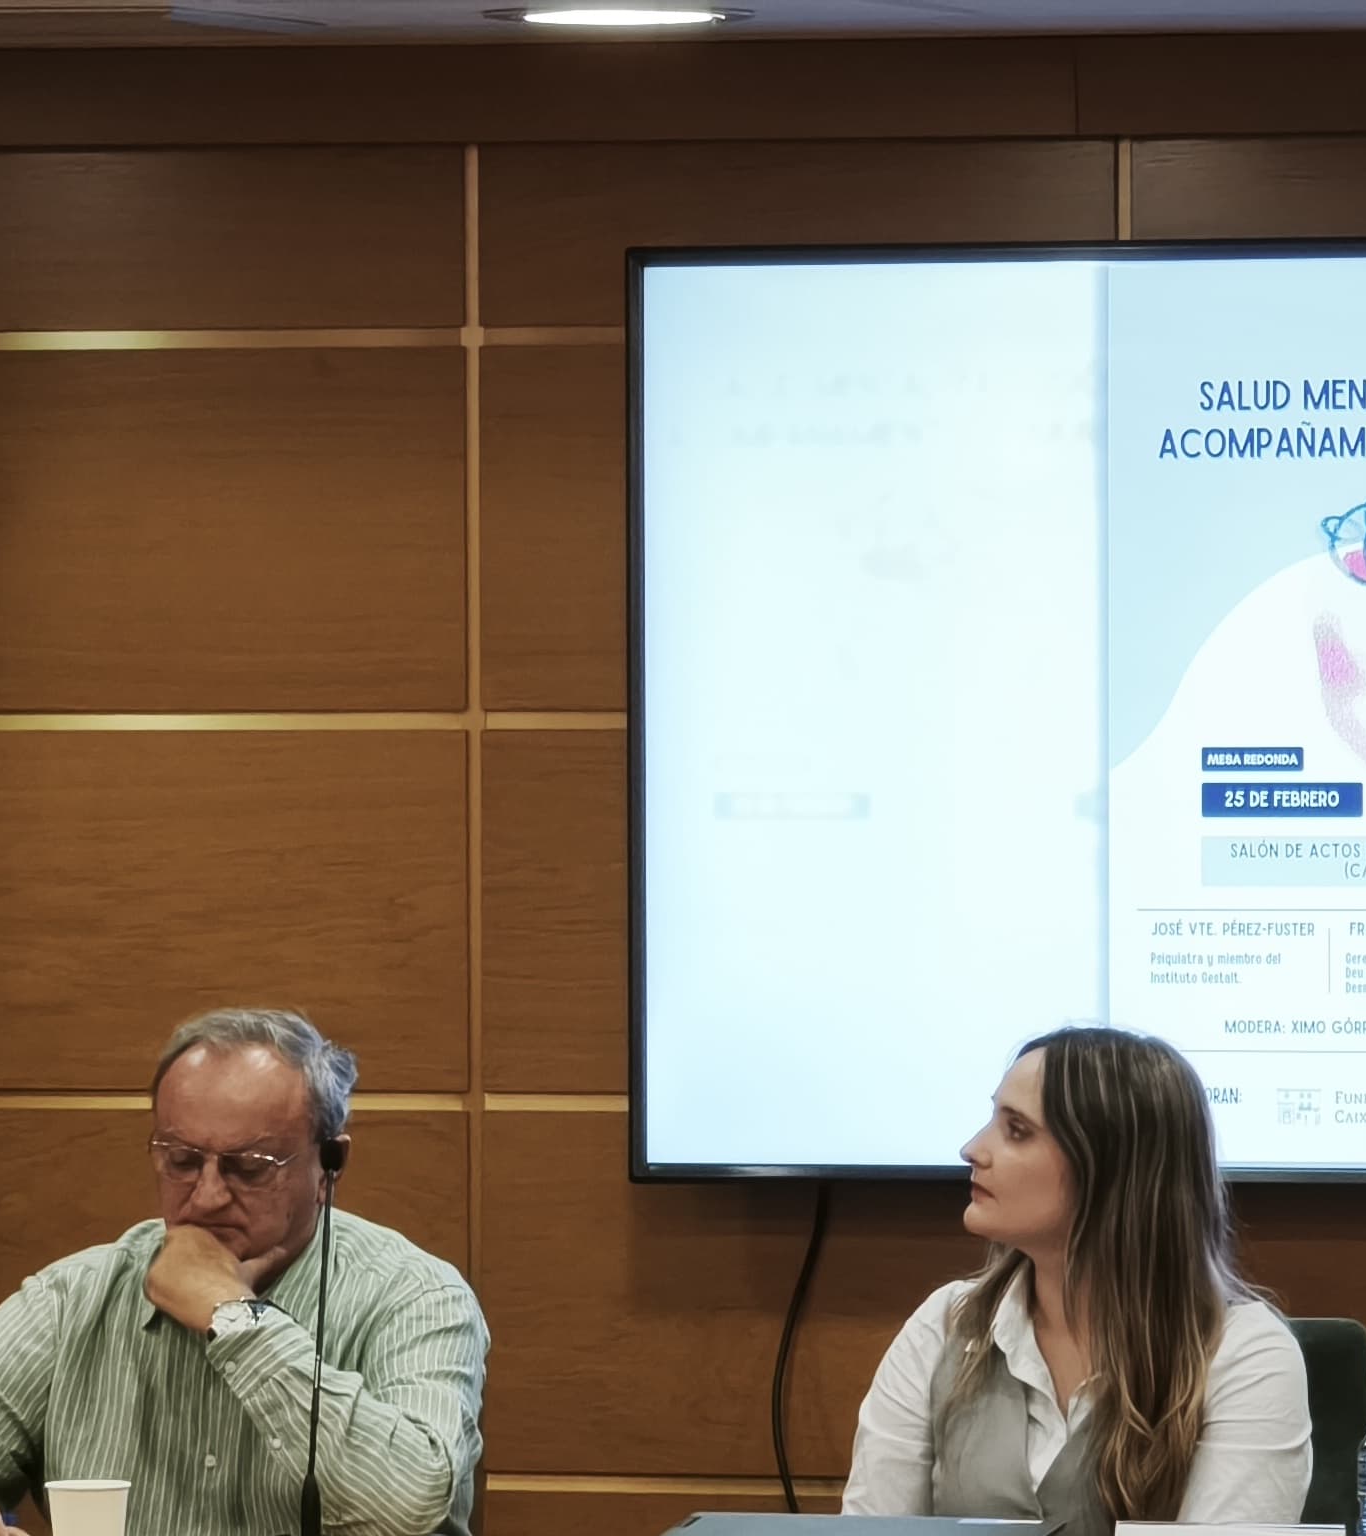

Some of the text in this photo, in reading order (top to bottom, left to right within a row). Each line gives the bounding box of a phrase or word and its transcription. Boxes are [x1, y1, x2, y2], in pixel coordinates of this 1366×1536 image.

[1199, 380, 1291, 411] SALUD
[1207, 754, 1298, 766] MESA REDONDA
[1225, 790, 1339, 808] 25 DE FEBRERO
[1231, 840, 1278, 858] SALÓN
[1285, 843, 1303, 858] DE
[1310, 842, 1361, 858] ACTOS
[1151, 919, 1183, 936] JOSÉ
[1222, 919, 1315, 936] PÉREZ-FUSTER
[1150, 952, 1281, 967] Psiquiatra y miembro del
[1150, 972, 1198, 984] Instituto
[1224, 1019, 1285, 1034] MODERA:
[1291, 1019, 1326, 1034] XIMO
